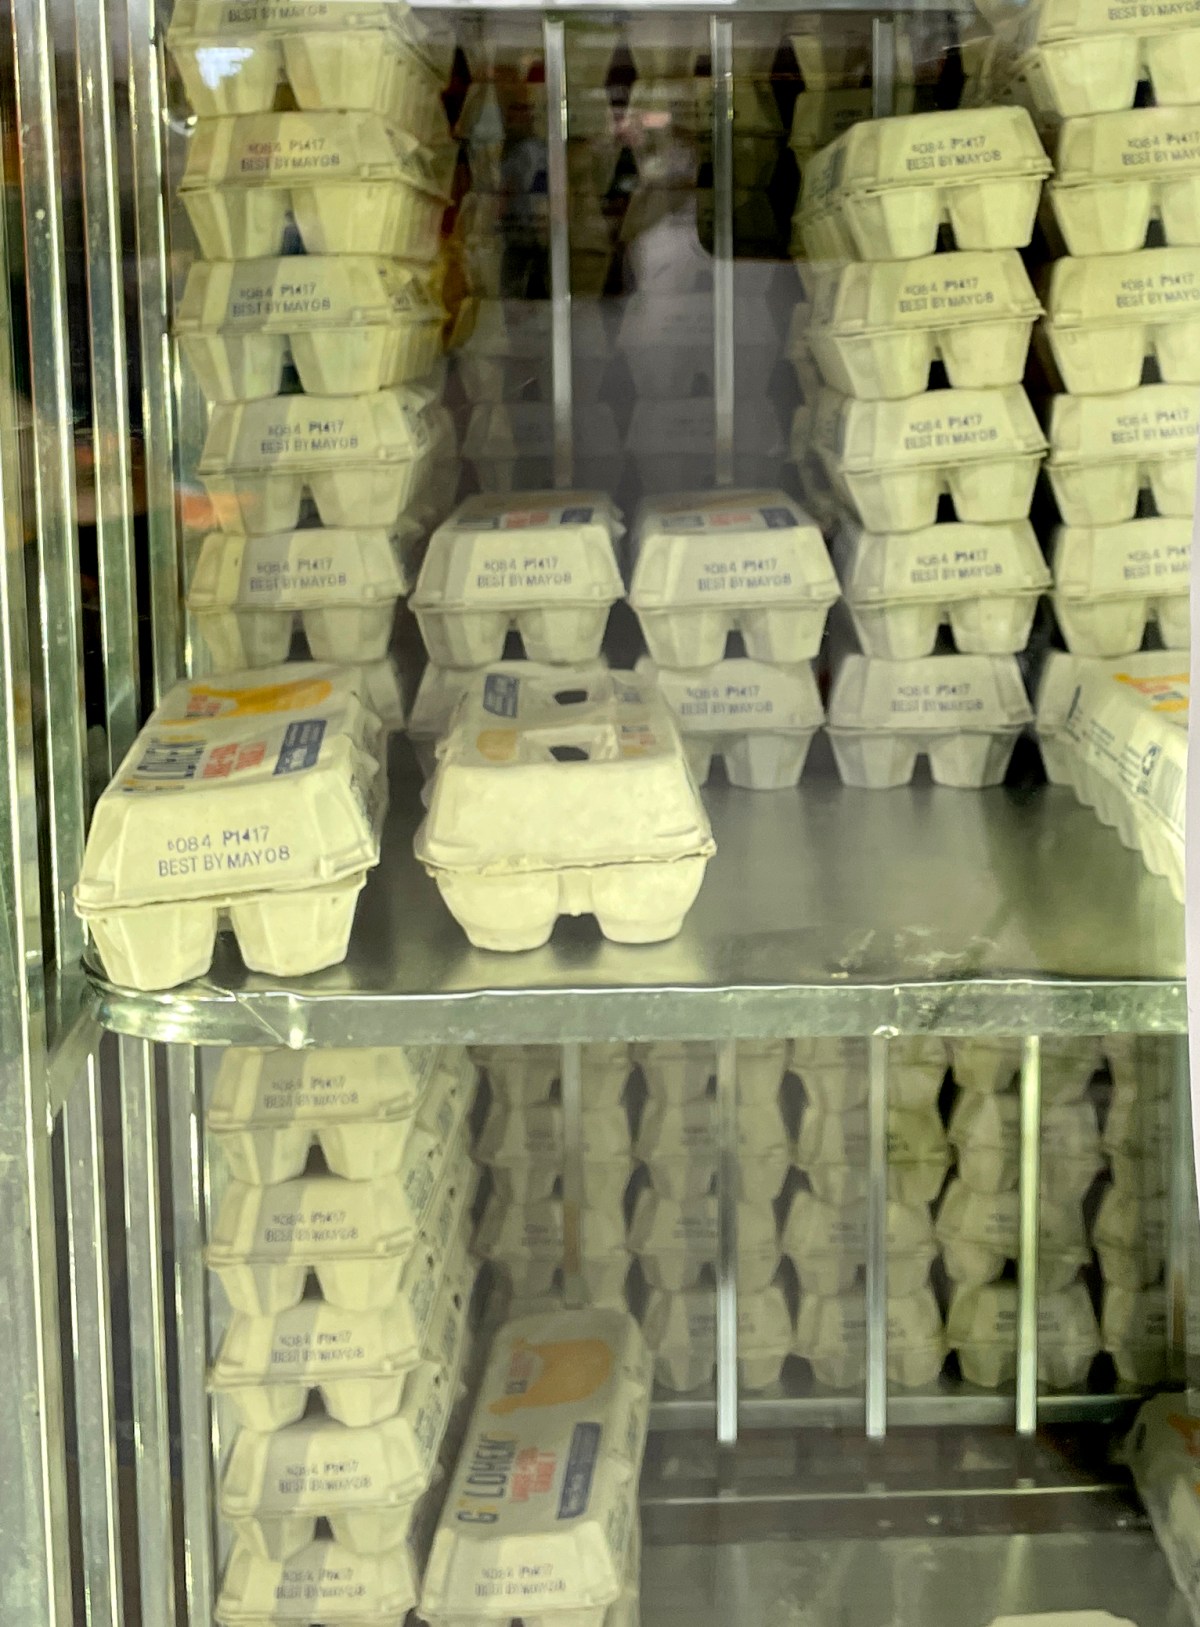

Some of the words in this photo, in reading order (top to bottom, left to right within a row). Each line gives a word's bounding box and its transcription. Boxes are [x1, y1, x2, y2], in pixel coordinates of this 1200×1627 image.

[1108, 6, 1137, 20] BEST
[241, 157, 271, 170] BEST
[906, 156, 935, 170] BEST
[1122, 150, 1150, 165] BEST
[900, 298, 928, 313] BEST
[1116, 293, 1144, 308] BEST
[232, 302, 262, 317] BEST
[904, 434, 933, 449] BEST
[1110, 428, 1139, 444] BEST
[261, 440, 291, 454] BEST
[910, 568, 938, 583] BEST
[1124, 565, 1152, 580] BEST
[250, 577, 280, 591] BEST
[477, 574, 506, 588] BEST
[698, 577, 726, 591] BEST
[680, 702, 709, 715] BEST
[158, 855, 198, 877] BEST
